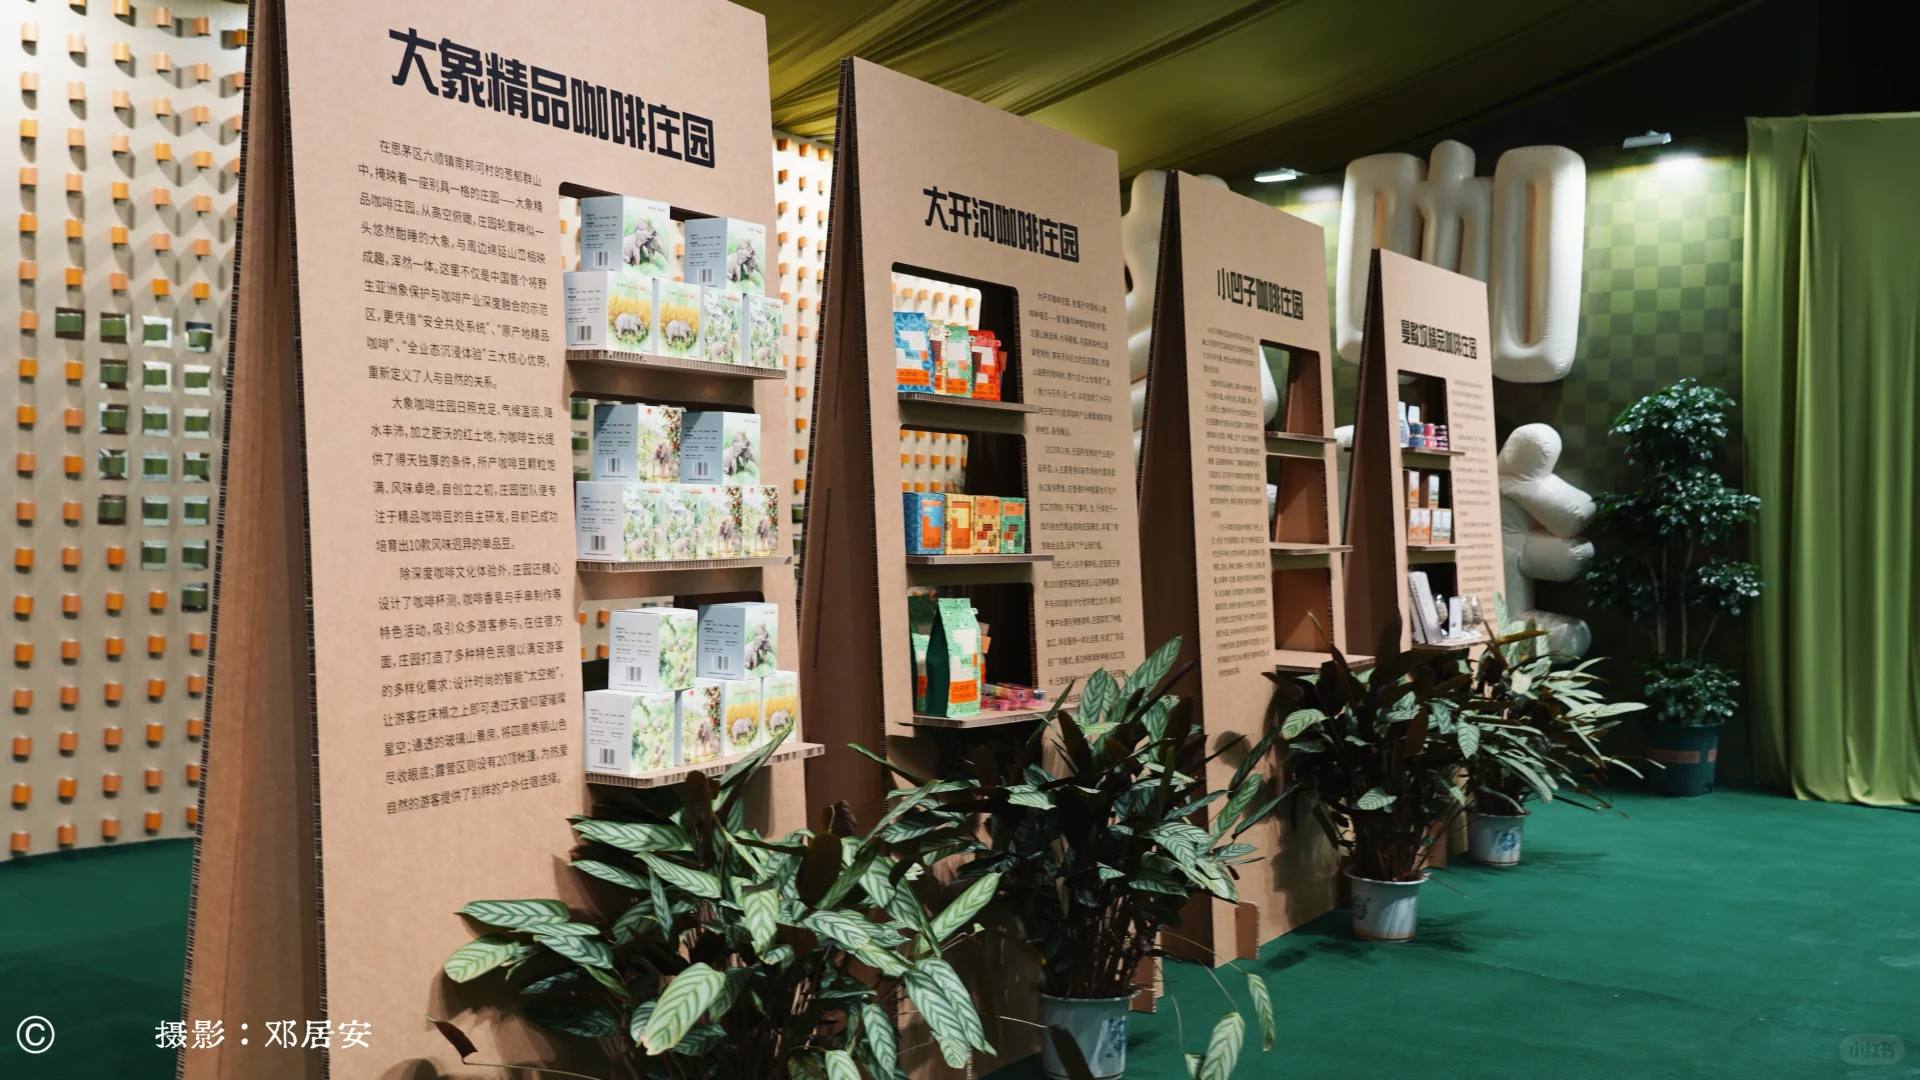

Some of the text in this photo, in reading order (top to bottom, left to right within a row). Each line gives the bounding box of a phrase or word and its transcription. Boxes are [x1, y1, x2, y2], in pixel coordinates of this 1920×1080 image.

[388, 27, 716, 169] 大象精品咖啡庄园
[923, 186, 1080, 264] 大开河咖啡庄园
[364, 278, 548, 316] 生亚洲象保护与咖啡产业深度融合的示范
[1217, 268, 1304, 320] 小凹子咖啡庄园
[368, 365, 498, 389] 重新定义了人与自然的关系。
[374, 510, 558, 524] 注于精品咖啡豆的自主研发，目前已成功
